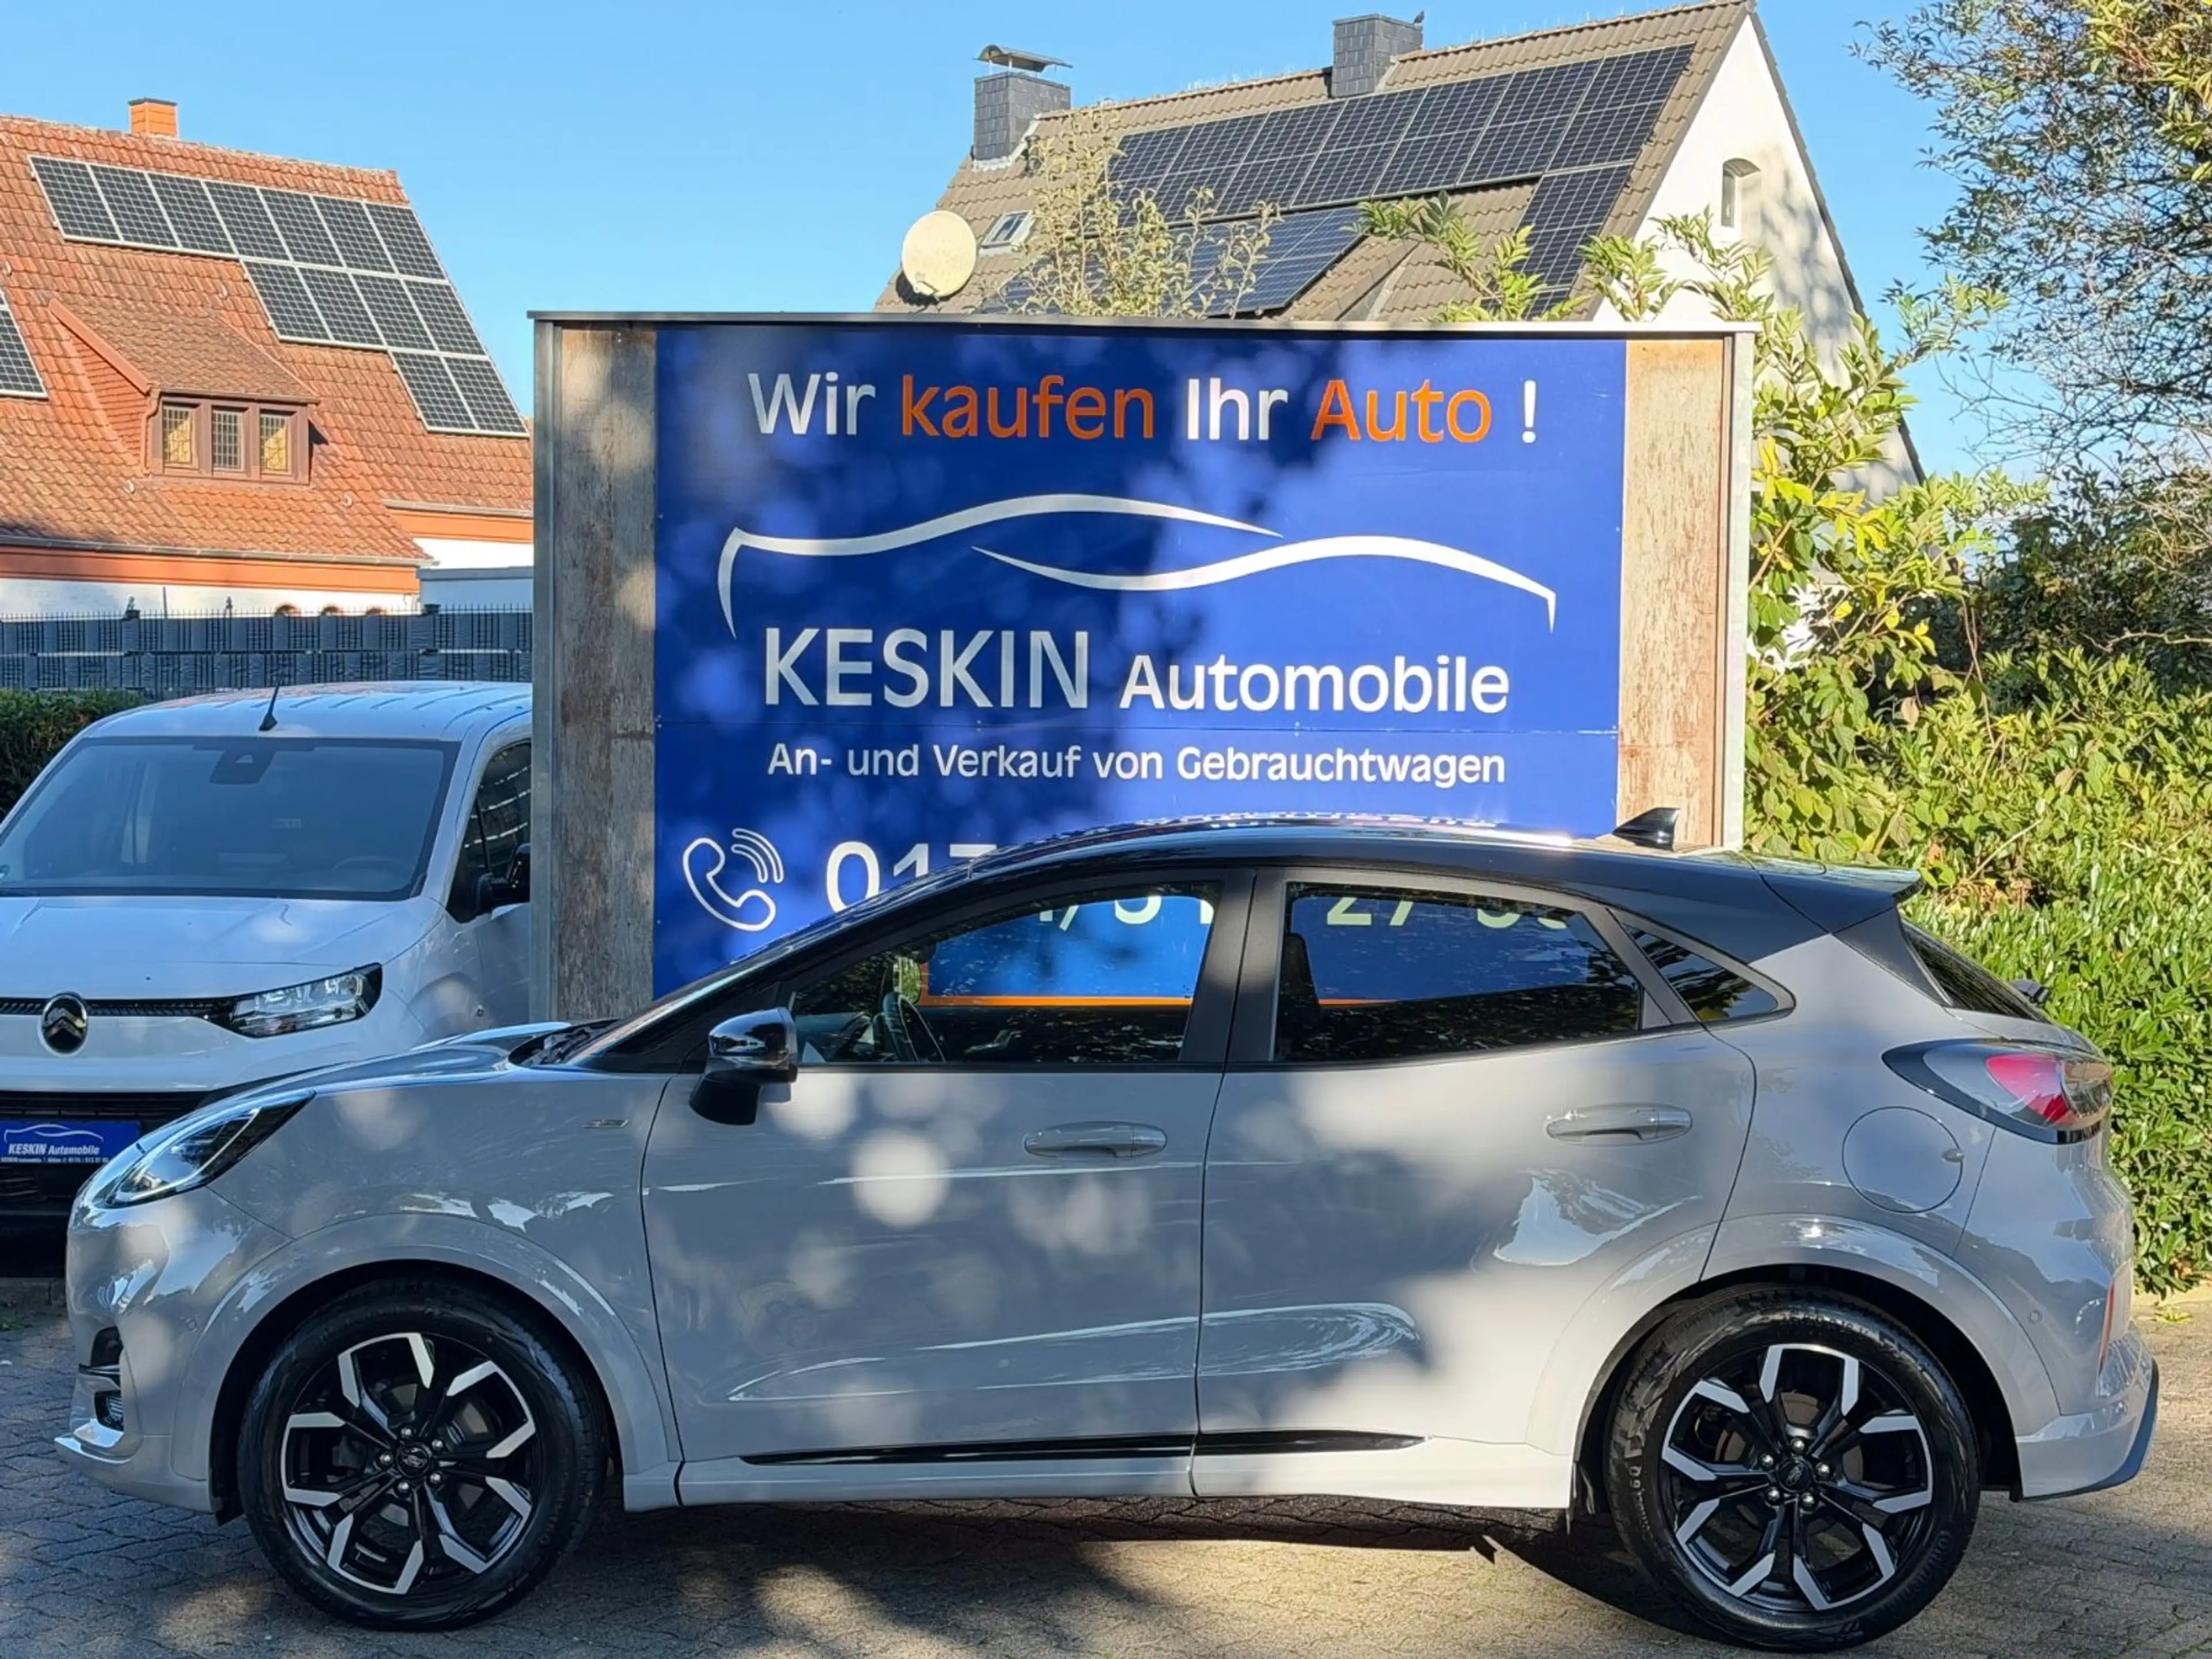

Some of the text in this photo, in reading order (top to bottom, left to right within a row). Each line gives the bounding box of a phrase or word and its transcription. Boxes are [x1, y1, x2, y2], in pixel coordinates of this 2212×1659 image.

[747, 372, 874, 435] Wir
[903, 375, 1153, 439] kaufen
[1185, 377, 1288, 441] Ihr
[1311, 378, 1493, 444] Auto
[766, 628, 1510, 714] KESKIN Automobile
[769, 744, 1505, 789] An- und Verkauf von Gebrauchtwagen
[8, 1143, 100, 1154] KESKIN Automobile
